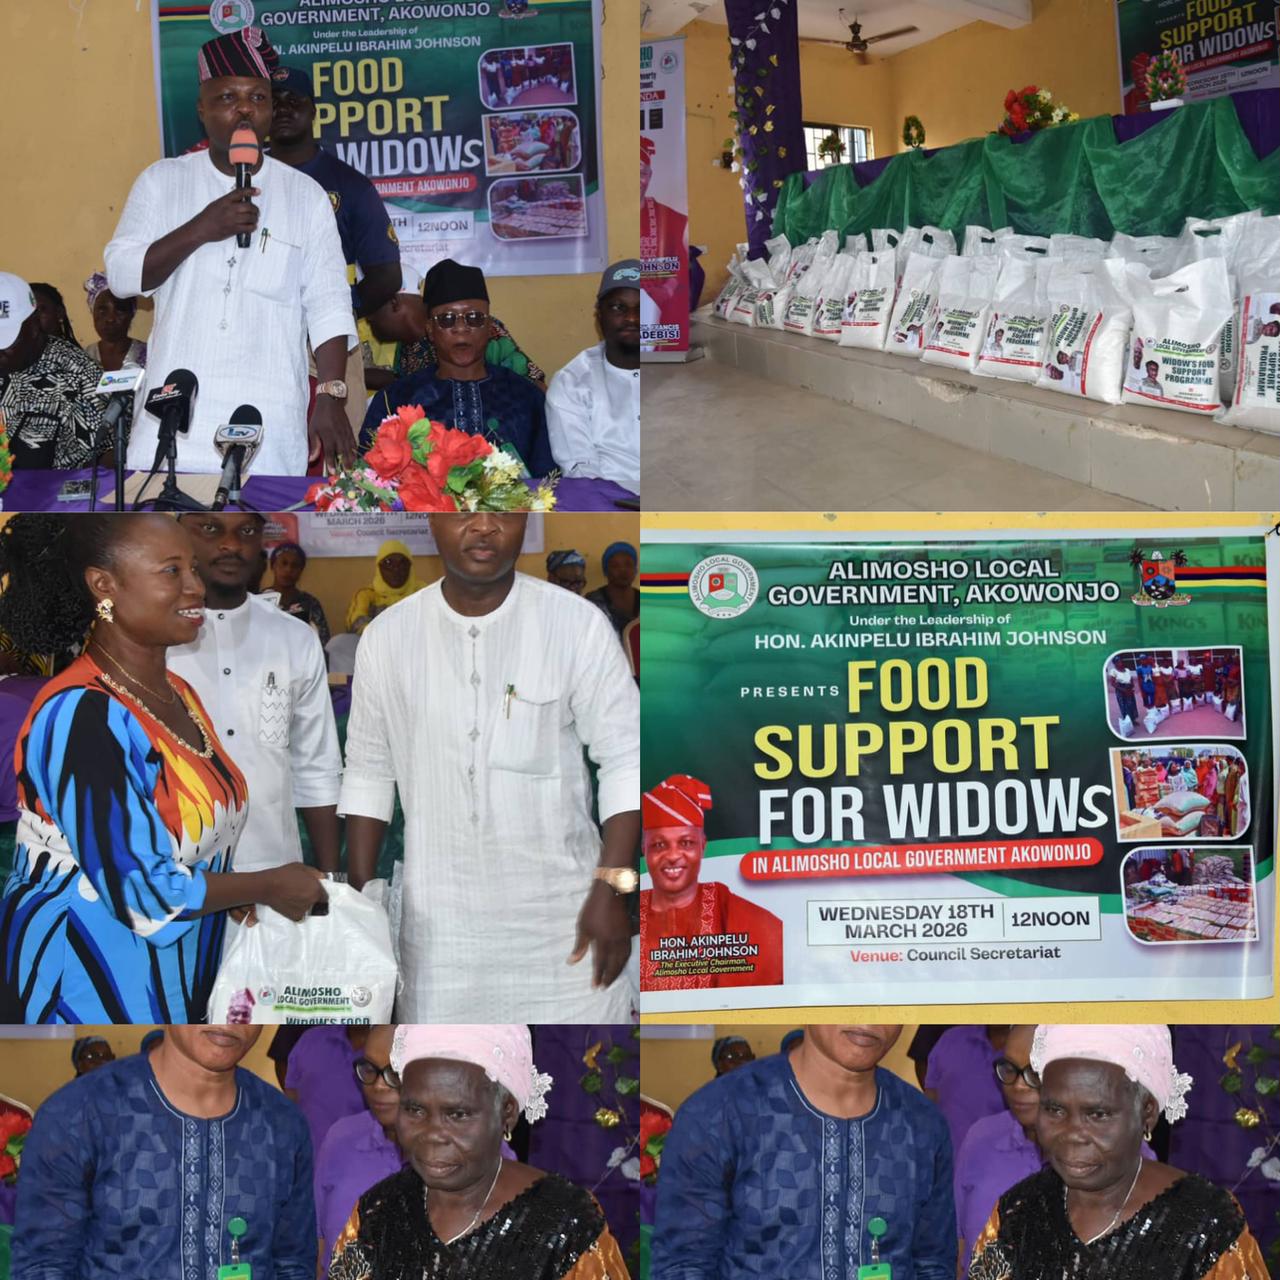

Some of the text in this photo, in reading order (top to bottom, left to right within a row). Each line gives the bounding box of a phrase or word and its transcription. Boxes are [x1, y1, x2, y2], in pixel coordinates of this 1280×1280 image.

[261, 3, 490, 26] GOVERNMENT, AKOWONJO
[313, 27, 407, 39] Under the Leadership
[1160, 2, 1257, 49] SUPPORT
[289, 36, 481, 55] AKINPELU IBRAHIM JOHNSON
[312, 57, 403, 97] FOOD
[311, 95, 449, 139] PPORT
[327, 518, 361, 526] MARCH
[829, 558, 1059, 582] ALIMOSHO LOCAL
[768, 582, 1120, 608] GOVERNMENT, AKOWONJO
[850, 613, 1011, 629] Under the Leadership of
[755, 630, 1107, 650] HON. AKINPELU IBRAHIM JOHNSON
[741, 685, 840, 697] PRESENTS
[847, 657, 988, 713] FOOD
[753, 716, 1060, 780] SUPPORT
[759, 784, 865, 845] FOR
[752, 843, 1091, 873] IN ALIMOSHO LOCAL GOVERNMENT AKOWONJO
[819, 904, 995, 922] WEDNESDAY 18TH
[1011, 911, 1090, 927] 12NOON
[845, 922, 968, 940] MARCH 2026
[660, 934, 748, 948] HON. AKINPELU
[651, 945, 758, 960] IBRAHIM JOHNSON
[850, 945, 1061, 963] Venue: Council Secretariat
[709, 965, 753, 973] Government
[284, 986, 341, 997] ALIMOSHO
[300, 997, 350, 1006] GOVERNMENT
